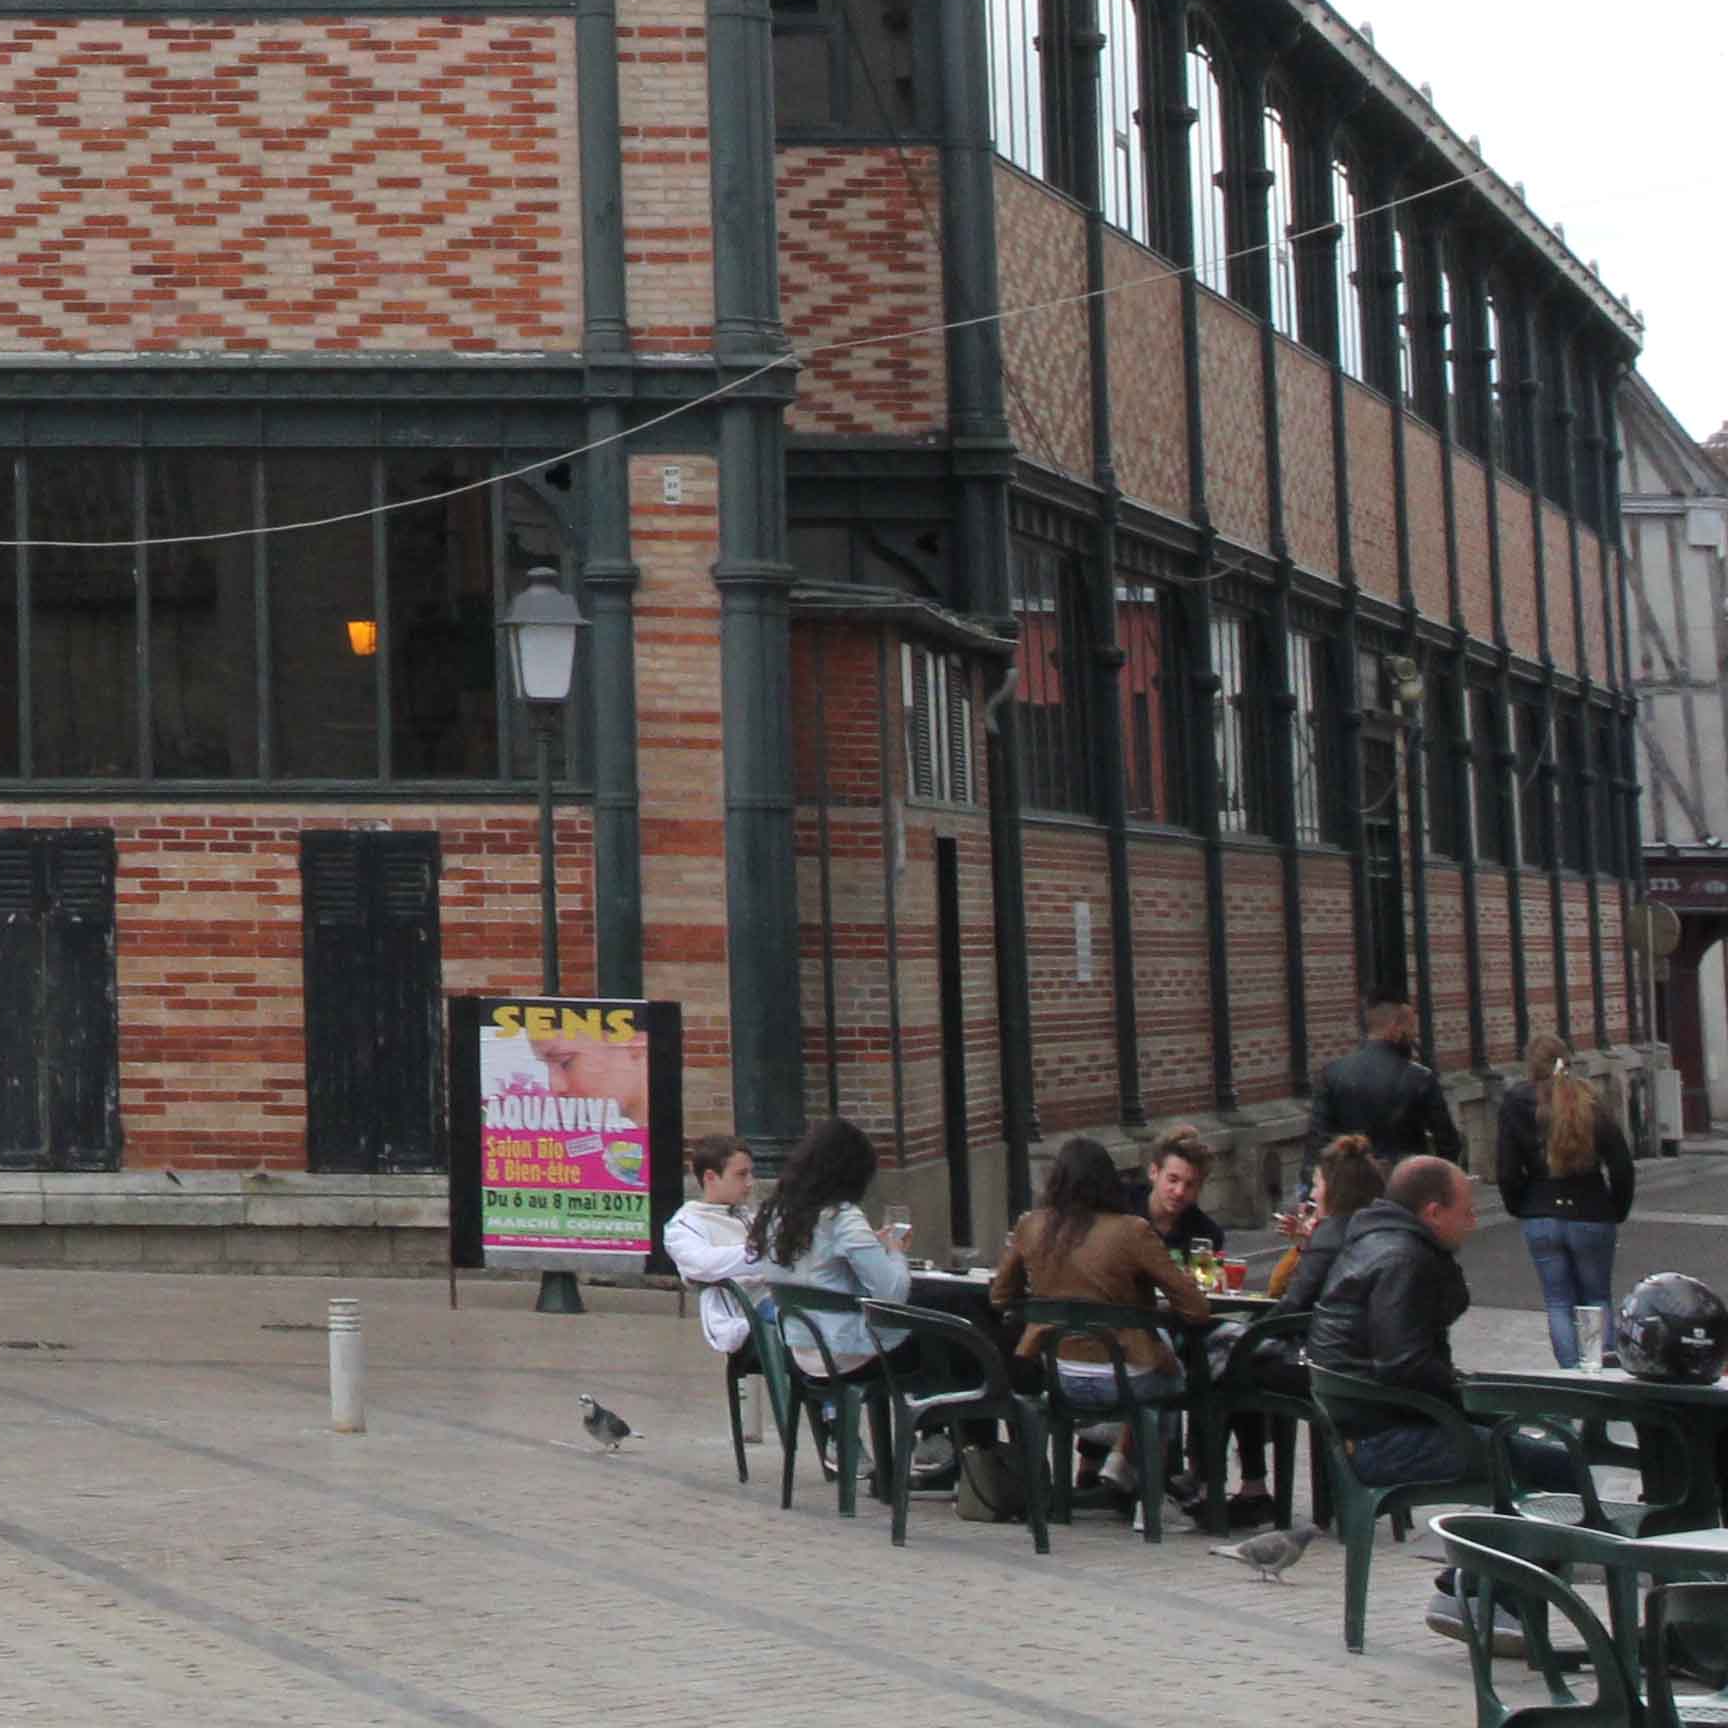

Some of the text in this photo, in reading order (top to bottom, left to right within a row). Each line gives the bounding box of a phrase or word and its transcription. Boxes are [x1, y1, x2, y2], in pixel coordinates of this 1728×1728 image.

[492, 1006, 636, 1042] SENS
[486, 1096, 625, 1132] AQUAVIVA
[486, 1136, 532, 1159] Salon
[538, 1137, 564, 1160] Bio
[487, 1159, 581, 1184] & Bien-être
[487, 1191, 644, 1212] Du 6 au 8 mai 2017
[567, 1219, 644, 1233] COUVERT
